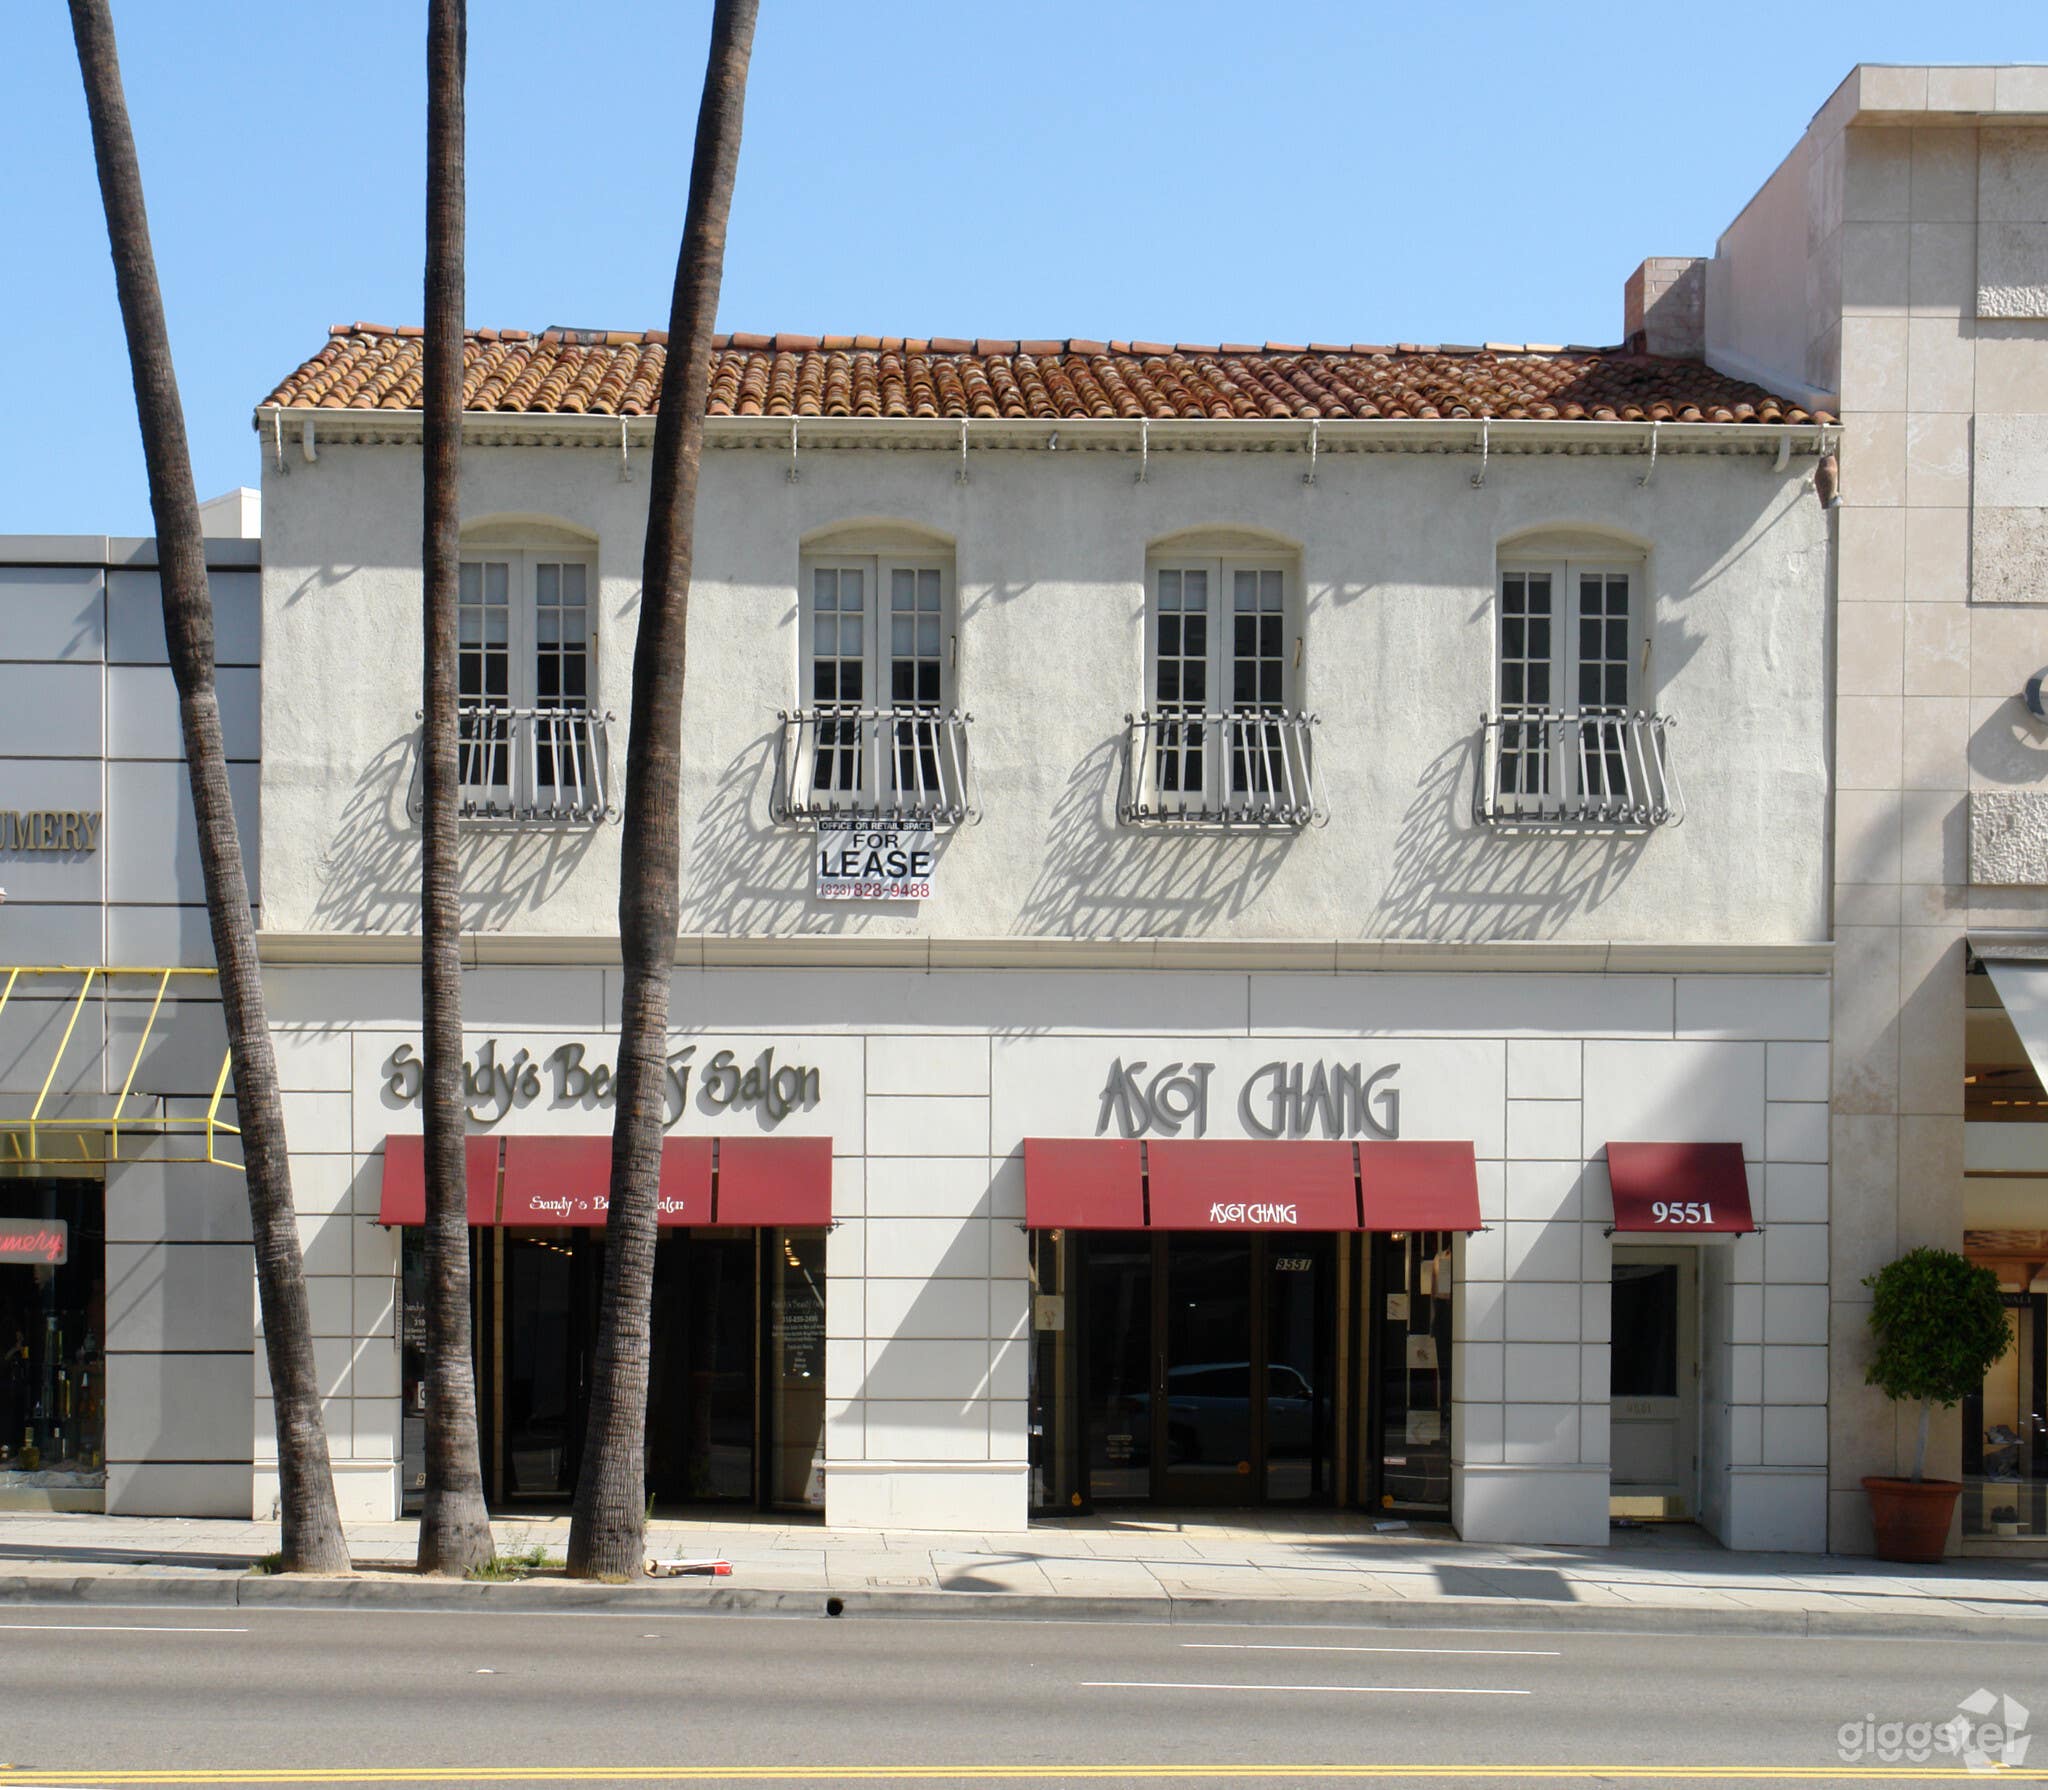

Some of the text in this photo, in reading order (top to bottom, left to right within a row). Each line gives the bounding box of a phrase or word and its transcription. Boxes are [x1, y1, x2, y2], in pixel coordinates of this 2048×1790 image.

[821, 822, 931, 831] OFFICE OR RETAIL SPACE
[853, 833, 899, 849] FOR
[821, 850, 930, 878] LEASE
[820, 882, 930, 898] (323) 828-9488
[705, 1048, 821, 1122] Salon
[1096, 1056, 1401, 1140] ASCOT CHANG
[656, 1196, 685, 1214] alon
[1209, 1202, 1298, 1225] ASCOT CHANG
[1651, 1201, 1717, 1224] 9551
[1276, 1258, 1312, 1271] 9551
